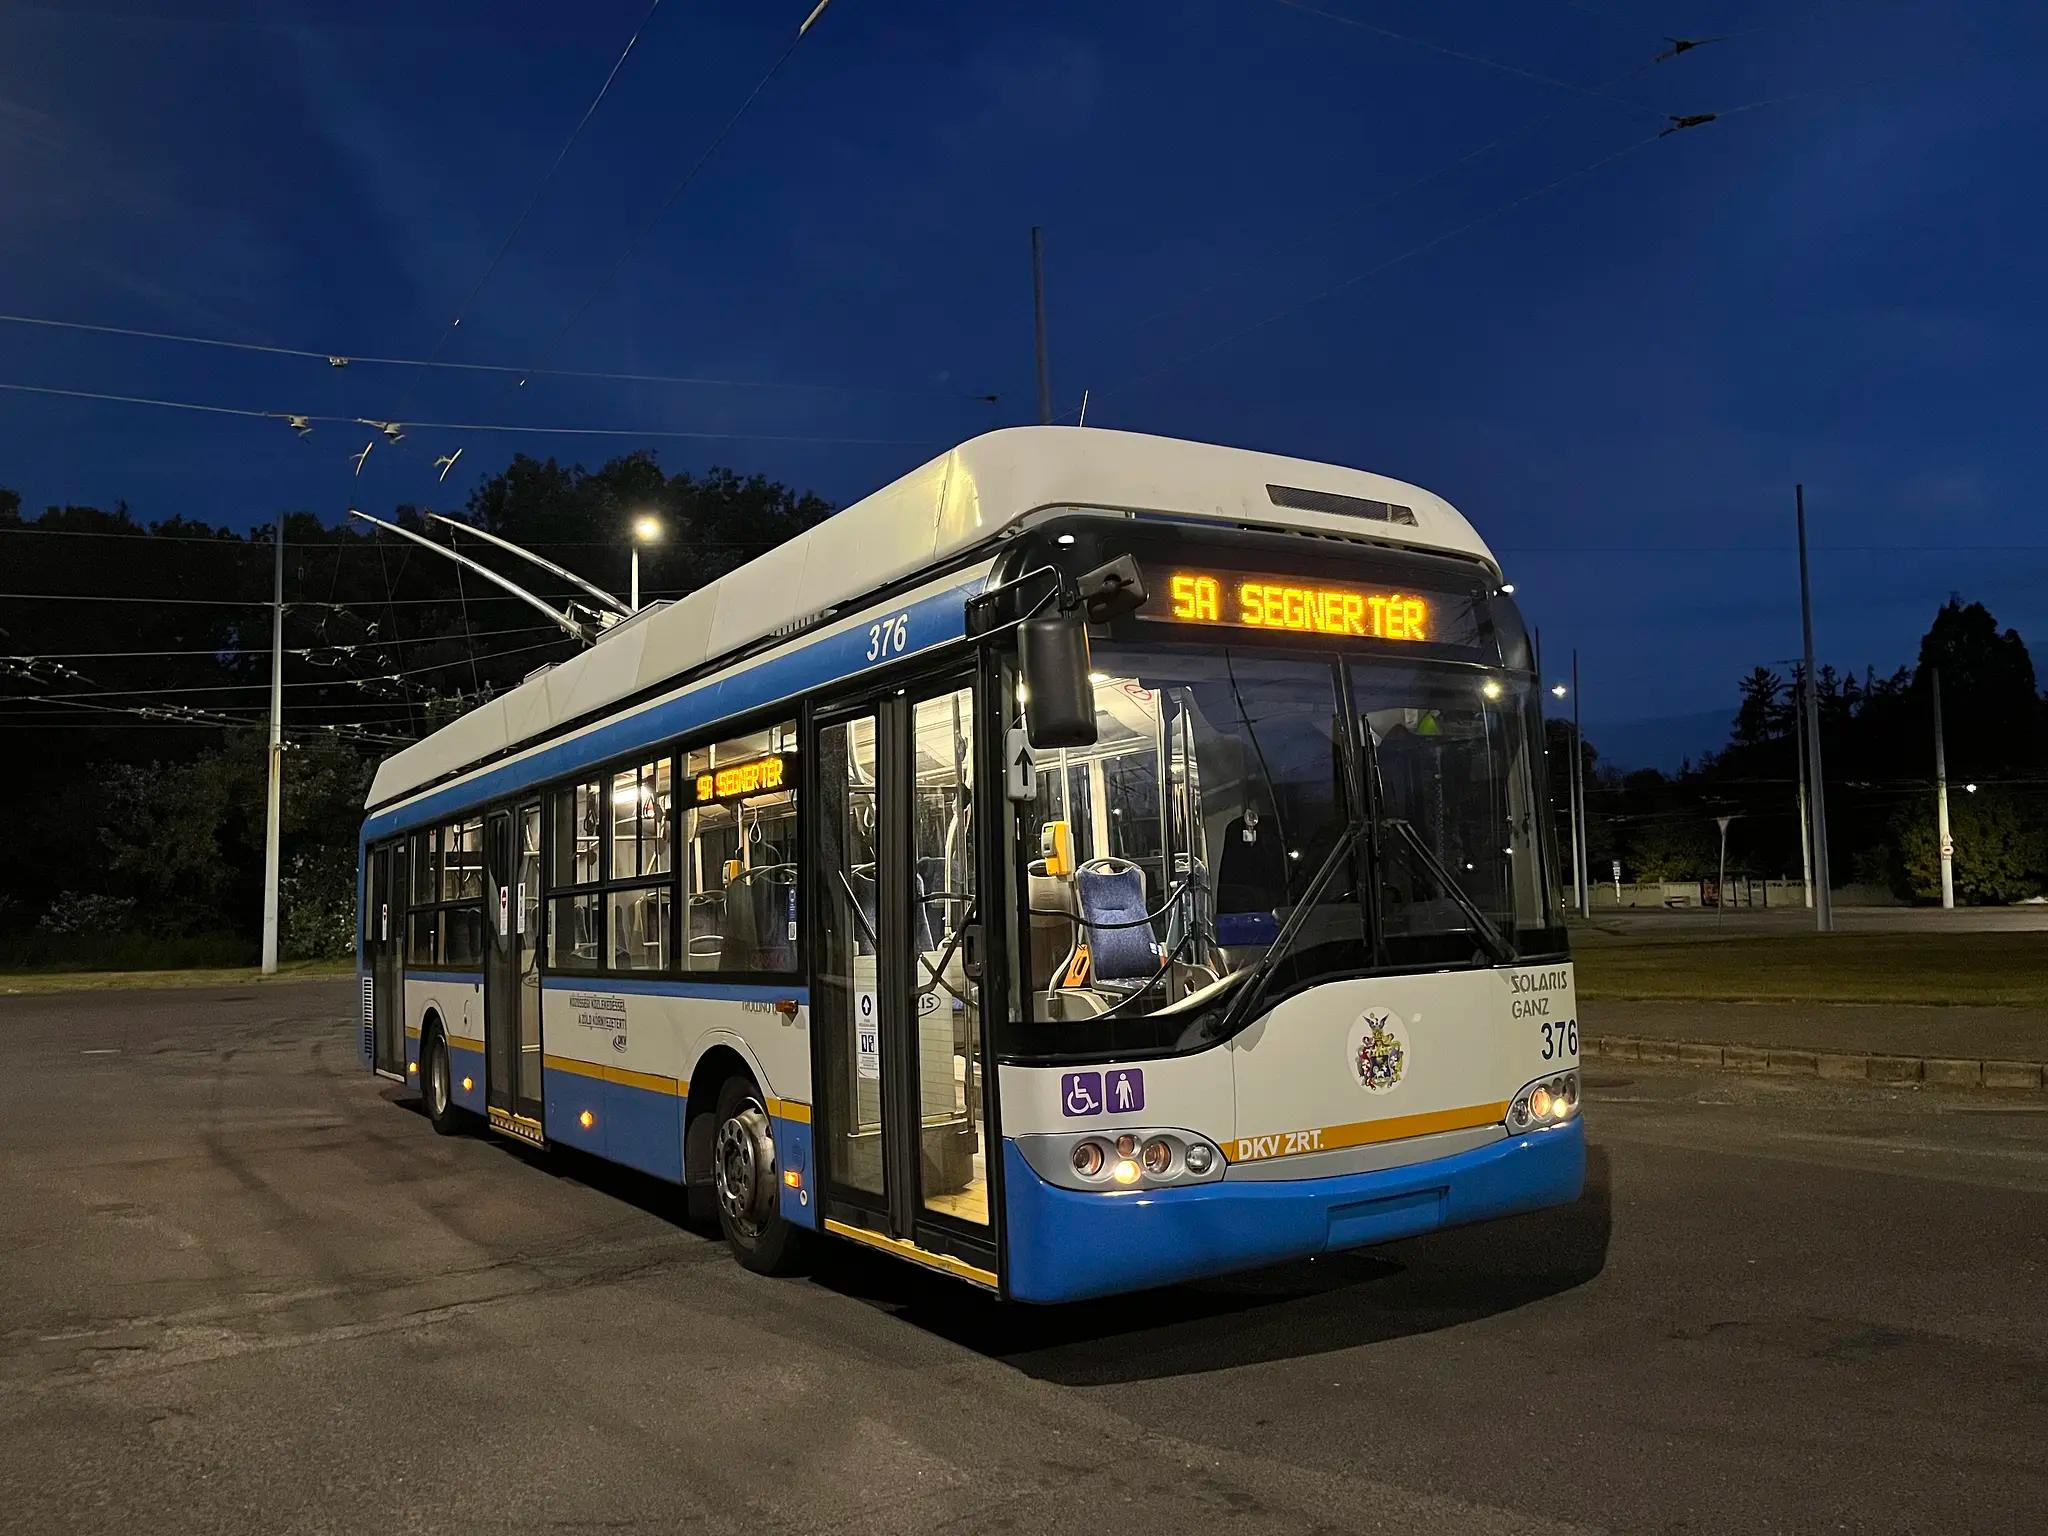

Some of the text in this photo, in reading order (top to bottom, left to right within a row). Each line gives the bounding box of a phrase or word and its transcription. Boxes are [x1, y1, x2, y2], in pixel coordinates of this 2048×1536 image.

[1171, 575, 1426, 641] 5A SEGNER TÉR
[866, 613, 908, 661] 376
[1510, 970, 1568, 994] SOLARIS
[919, 997, 934, 1009] IS
[1511, 998, 1550, 1019] GANZ
[1540, 1019, 1578, 1060] 376
[1238, 1129, 1325, 1160] DKV ZRT.
